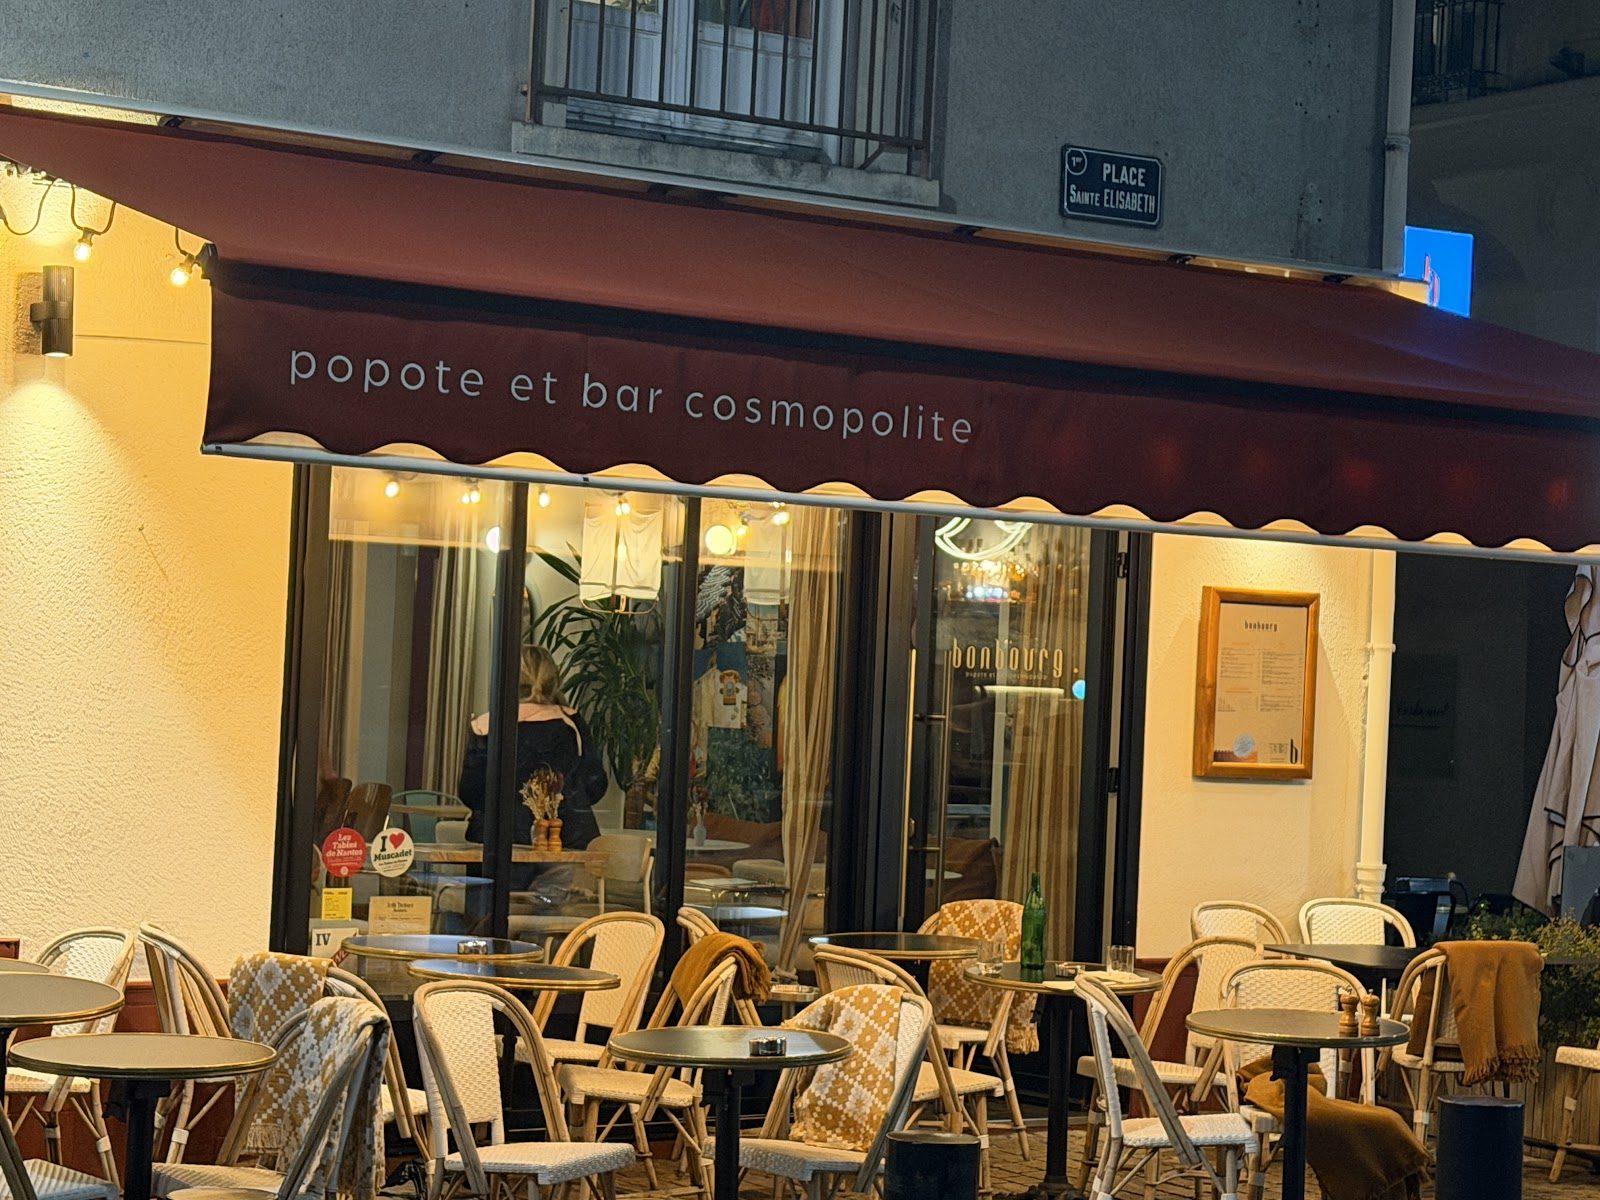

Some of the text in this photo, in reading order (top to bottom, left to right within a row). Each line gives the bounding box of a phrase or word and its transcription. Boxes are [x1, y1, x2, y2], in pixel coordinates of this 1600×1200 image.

[1102, 163, 1146, 187] PLACE
[1103, 188, 1156, 214] ELISABETH
[290, 350, 972, 443] popote et bar cosmopolite
[952, 637, 1063, 679] bonbourg
[373, 849, 413, 862] Muscadet
[380, 835, 388, 852] I
[315, 933, 331, 946] IV
